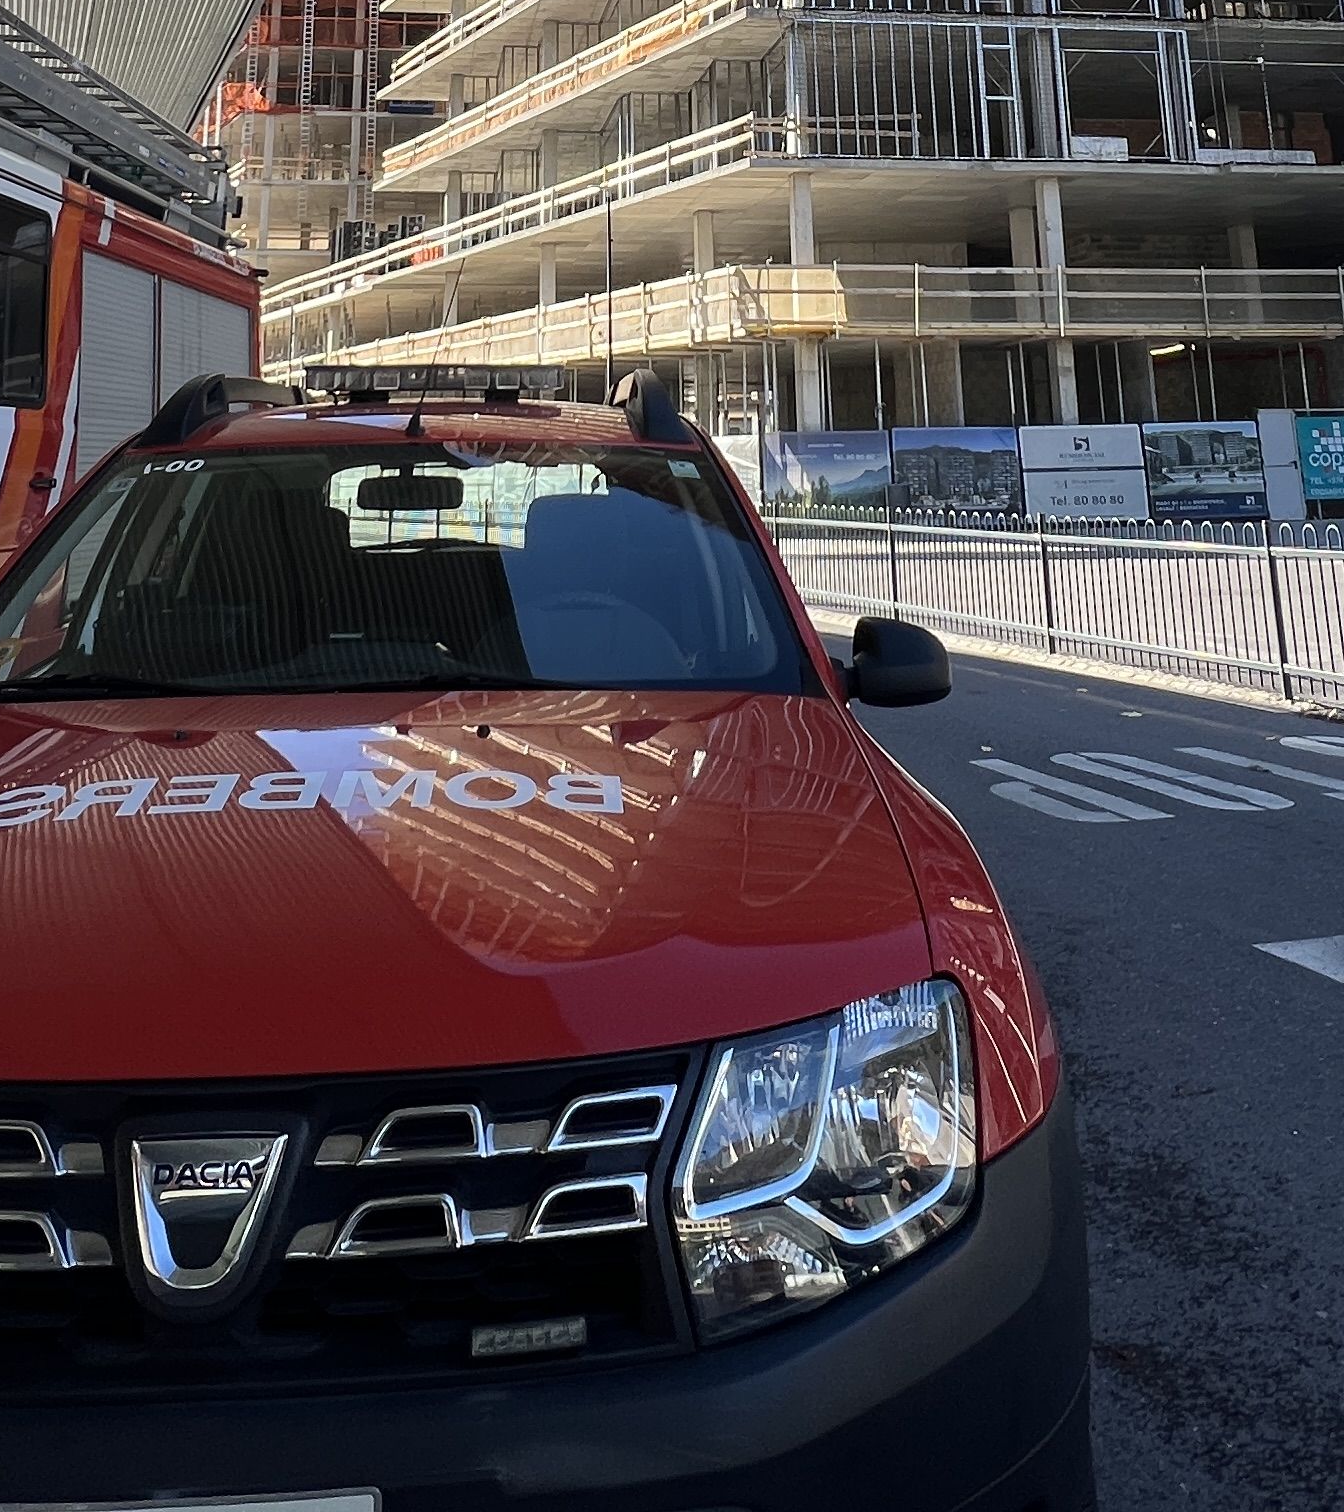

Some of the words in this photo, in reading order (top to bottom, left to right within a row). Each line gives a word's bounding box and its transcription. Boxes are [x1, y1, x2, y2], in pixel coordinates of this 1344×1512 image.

[1050, 495, 1071, 506] Tel.
[1074, 495, 1089, 506] 80
[1092, 495, 1107, 505] 80
[1110, 494, 1124, 505] 80
[153, 1159, 256, 1188] DACIA
